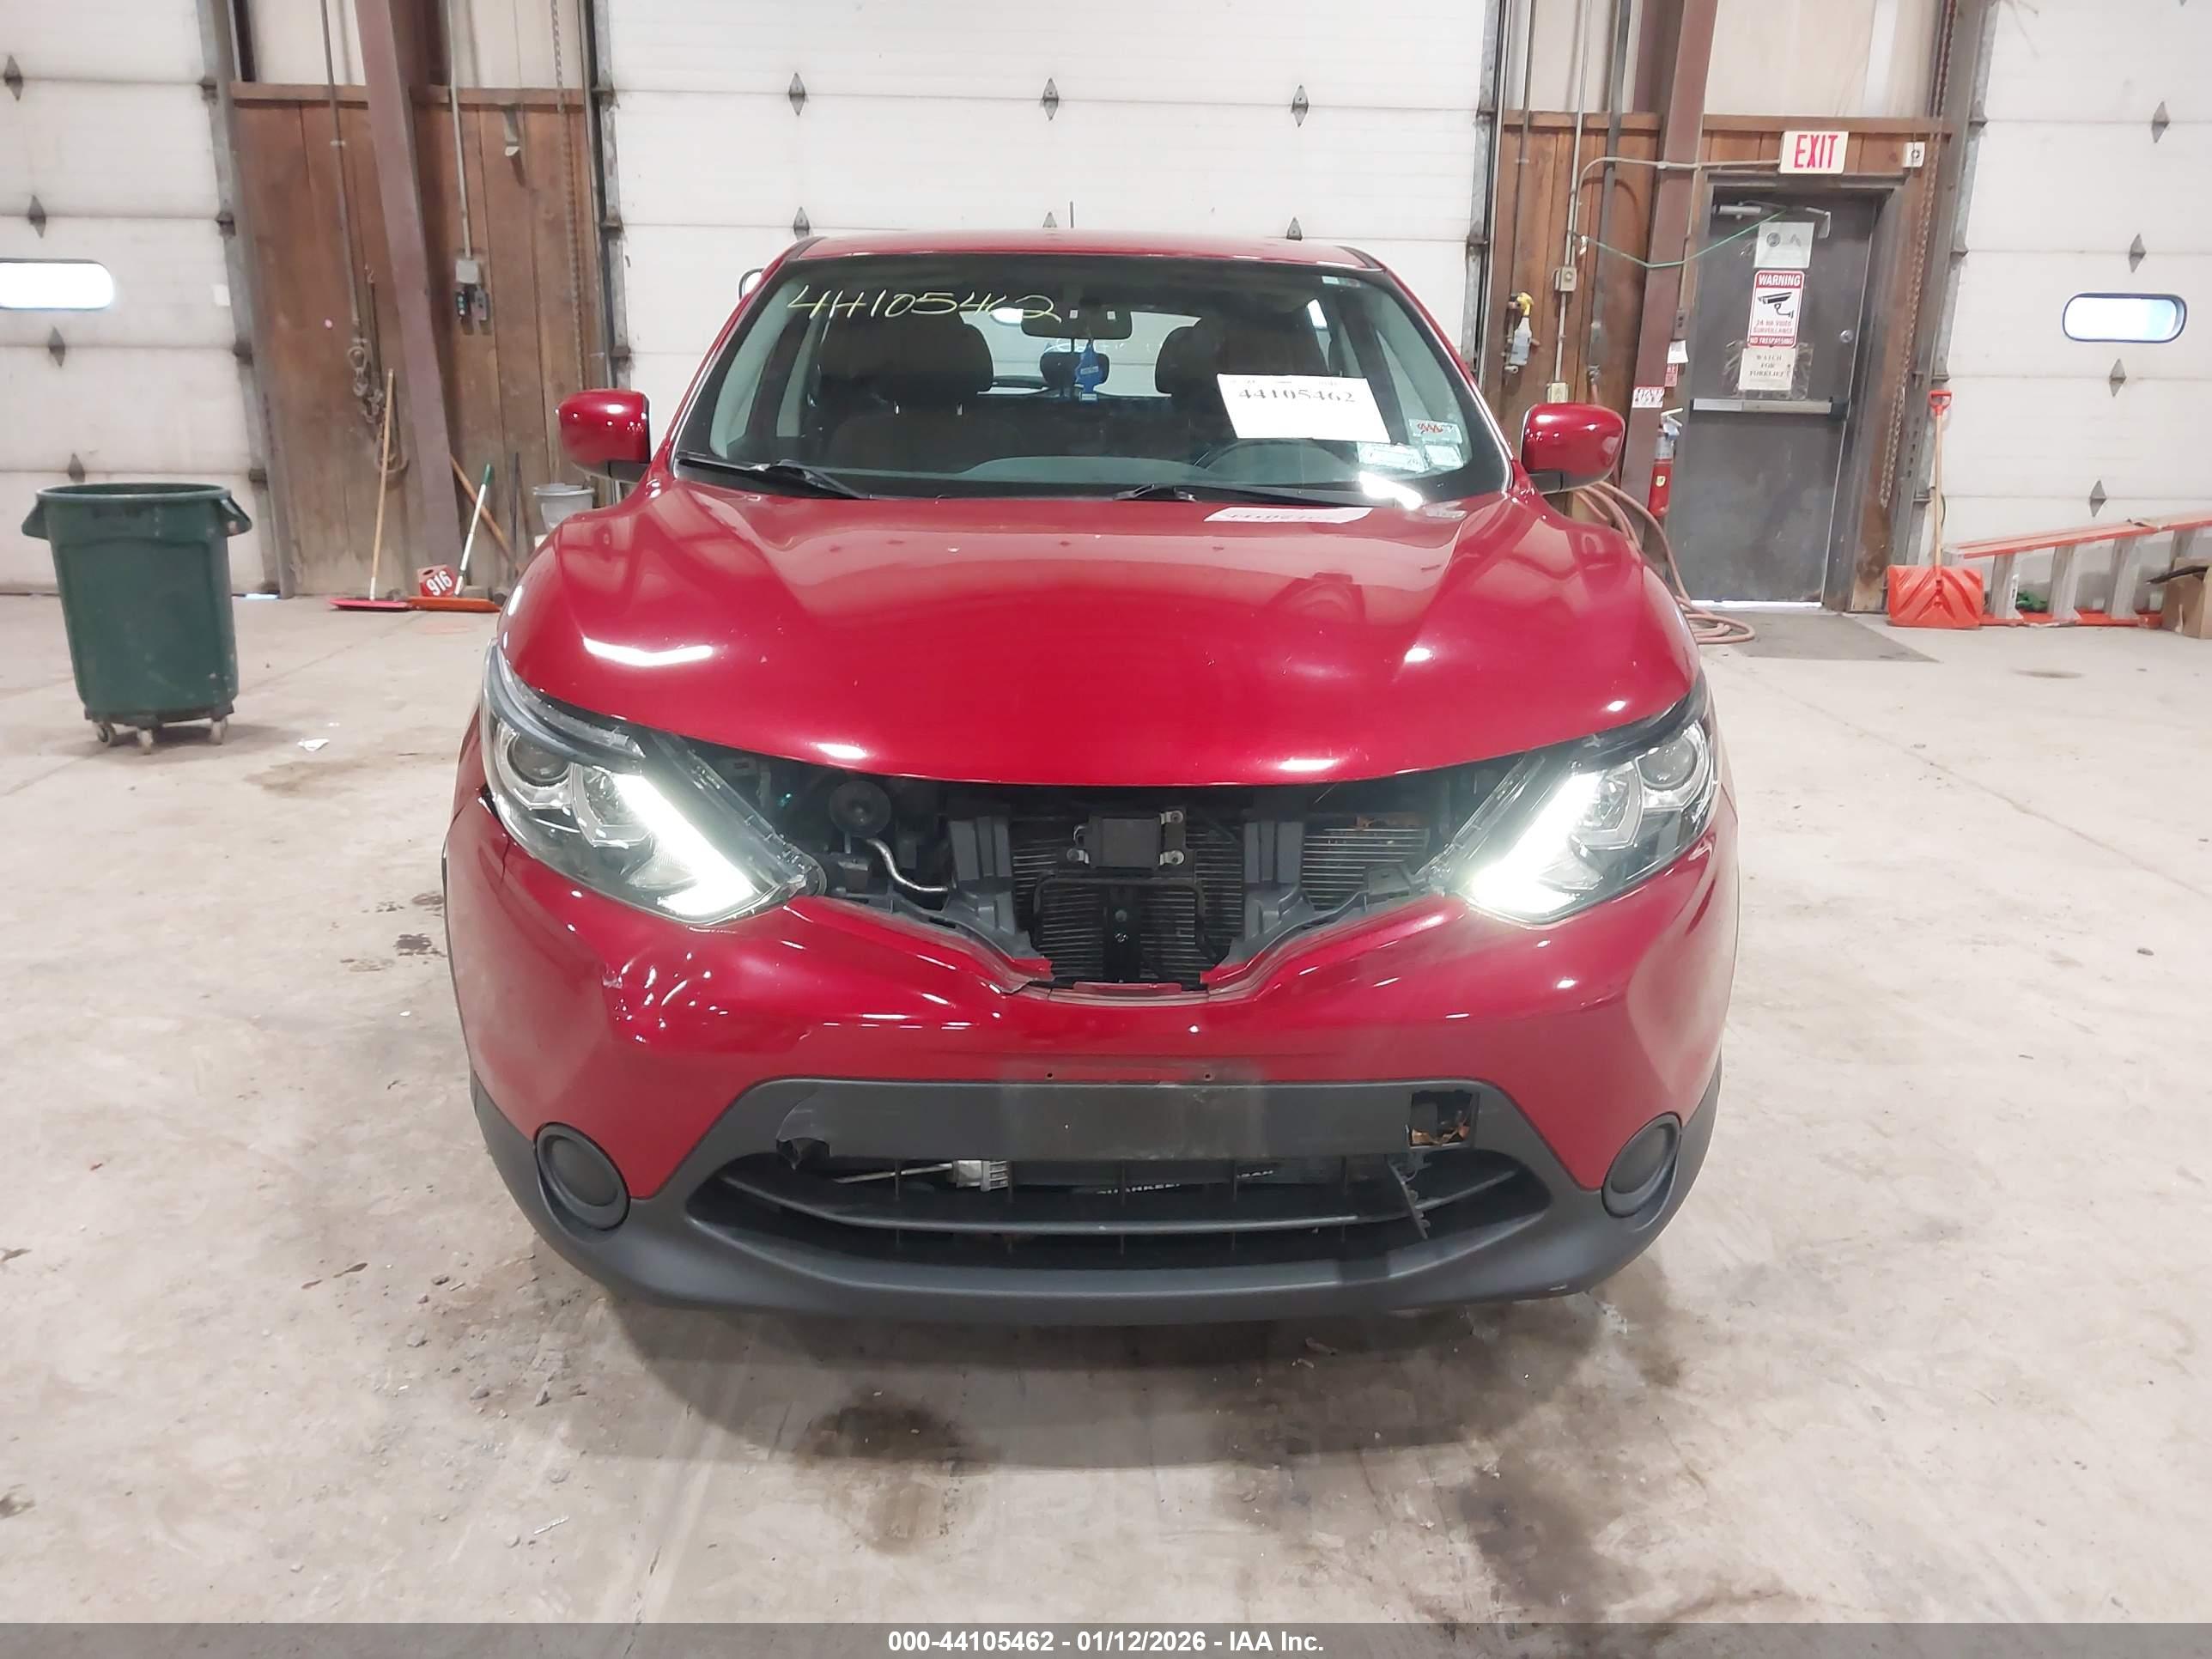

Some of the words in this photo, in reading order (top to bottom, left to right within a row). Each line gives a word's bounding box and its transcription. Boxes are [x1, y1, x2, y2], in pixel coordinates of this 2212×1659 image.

[1794, 134, 1838, 168] EXIT
[1758, 274, 1801, 286] WARNING
[426, 570, 453, 597] 916
